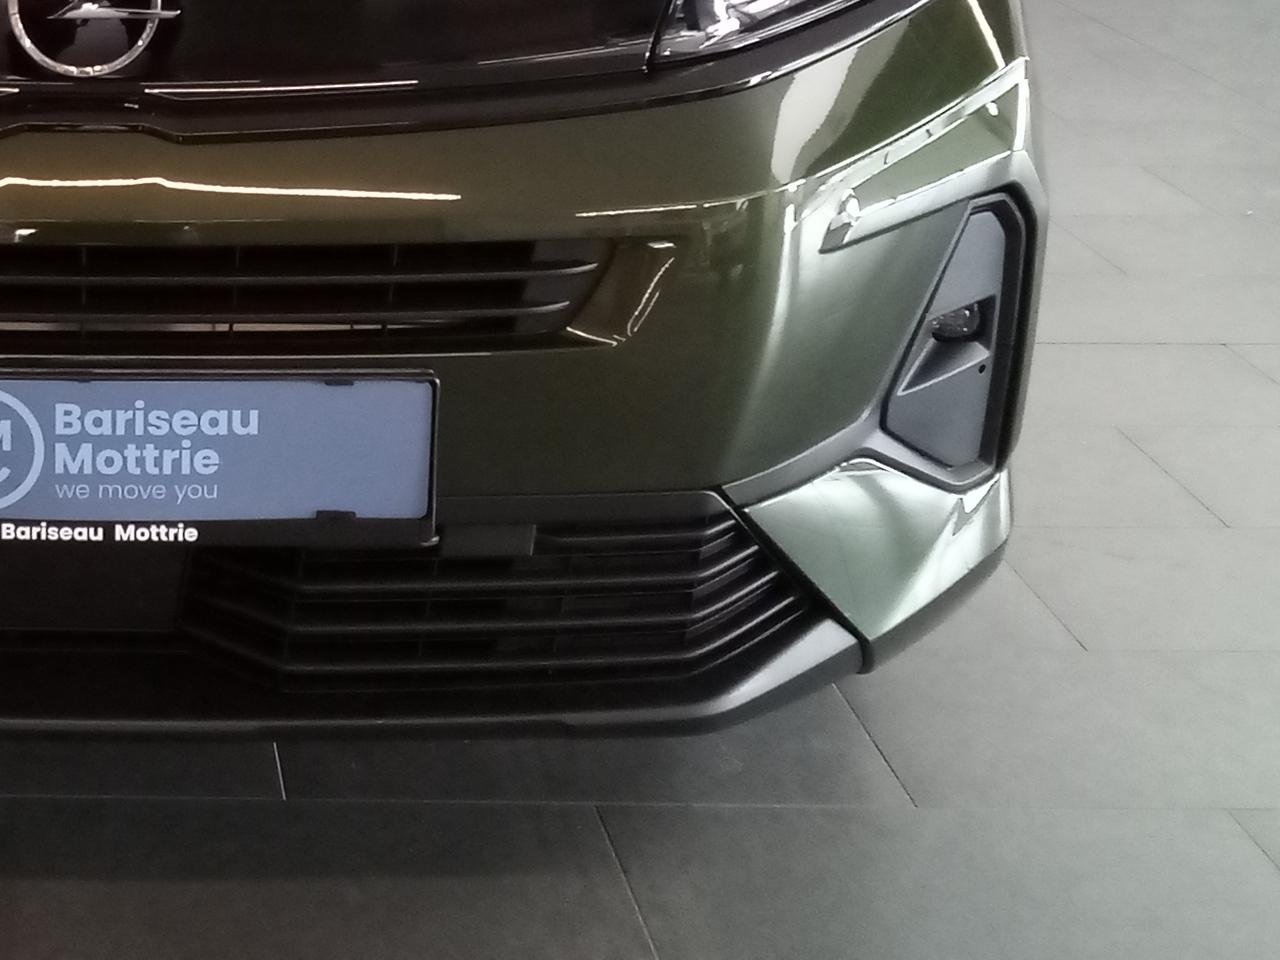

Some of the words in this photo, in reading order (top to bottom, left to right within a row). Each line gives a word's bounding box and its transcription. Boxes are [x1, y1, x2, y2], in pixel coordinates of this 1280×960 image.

[54, 400, 259, 436] Bariseau
[54, 440, 220, 475] Mottrie
[55, 482, 90, 499] we
[99, 482, 166, 499] move
[174, 482, 218, 504] you
[1, 521, 104, 541] Bariseau
[114, 523, 199, 542] Mottrie
